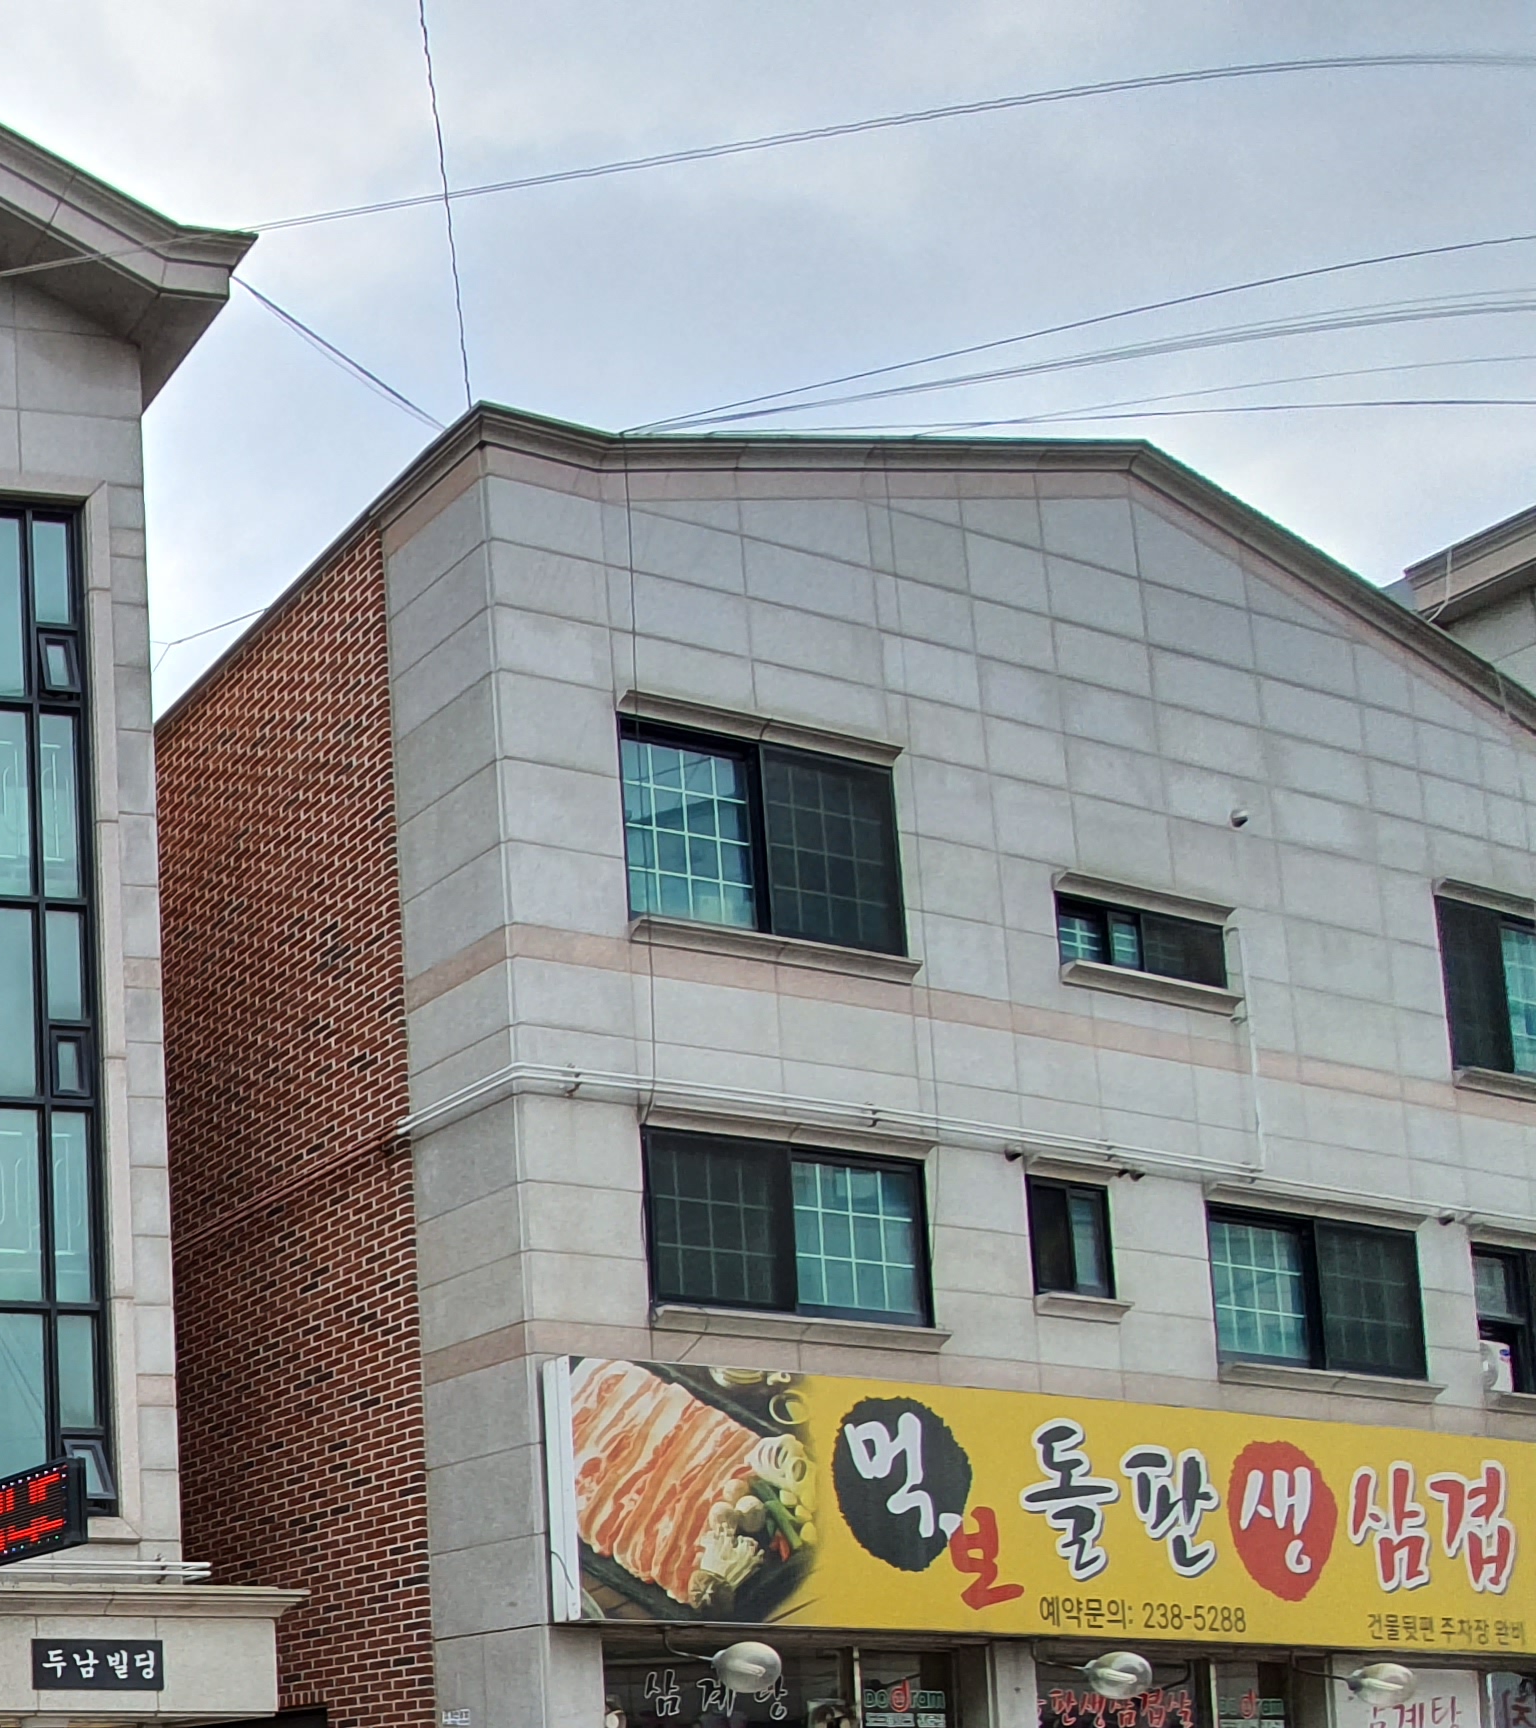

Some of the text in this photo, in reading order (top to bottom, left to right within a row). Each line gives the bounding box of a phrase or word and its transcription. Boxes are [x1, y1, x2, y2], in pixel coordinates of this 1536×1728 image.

[1039, 1595, 1247, 1633] 예약문의: 238-5288
[1439, 1615, 1489, 1646] 주차장
[41, 1648, 156, 1680] 두남빌딩
